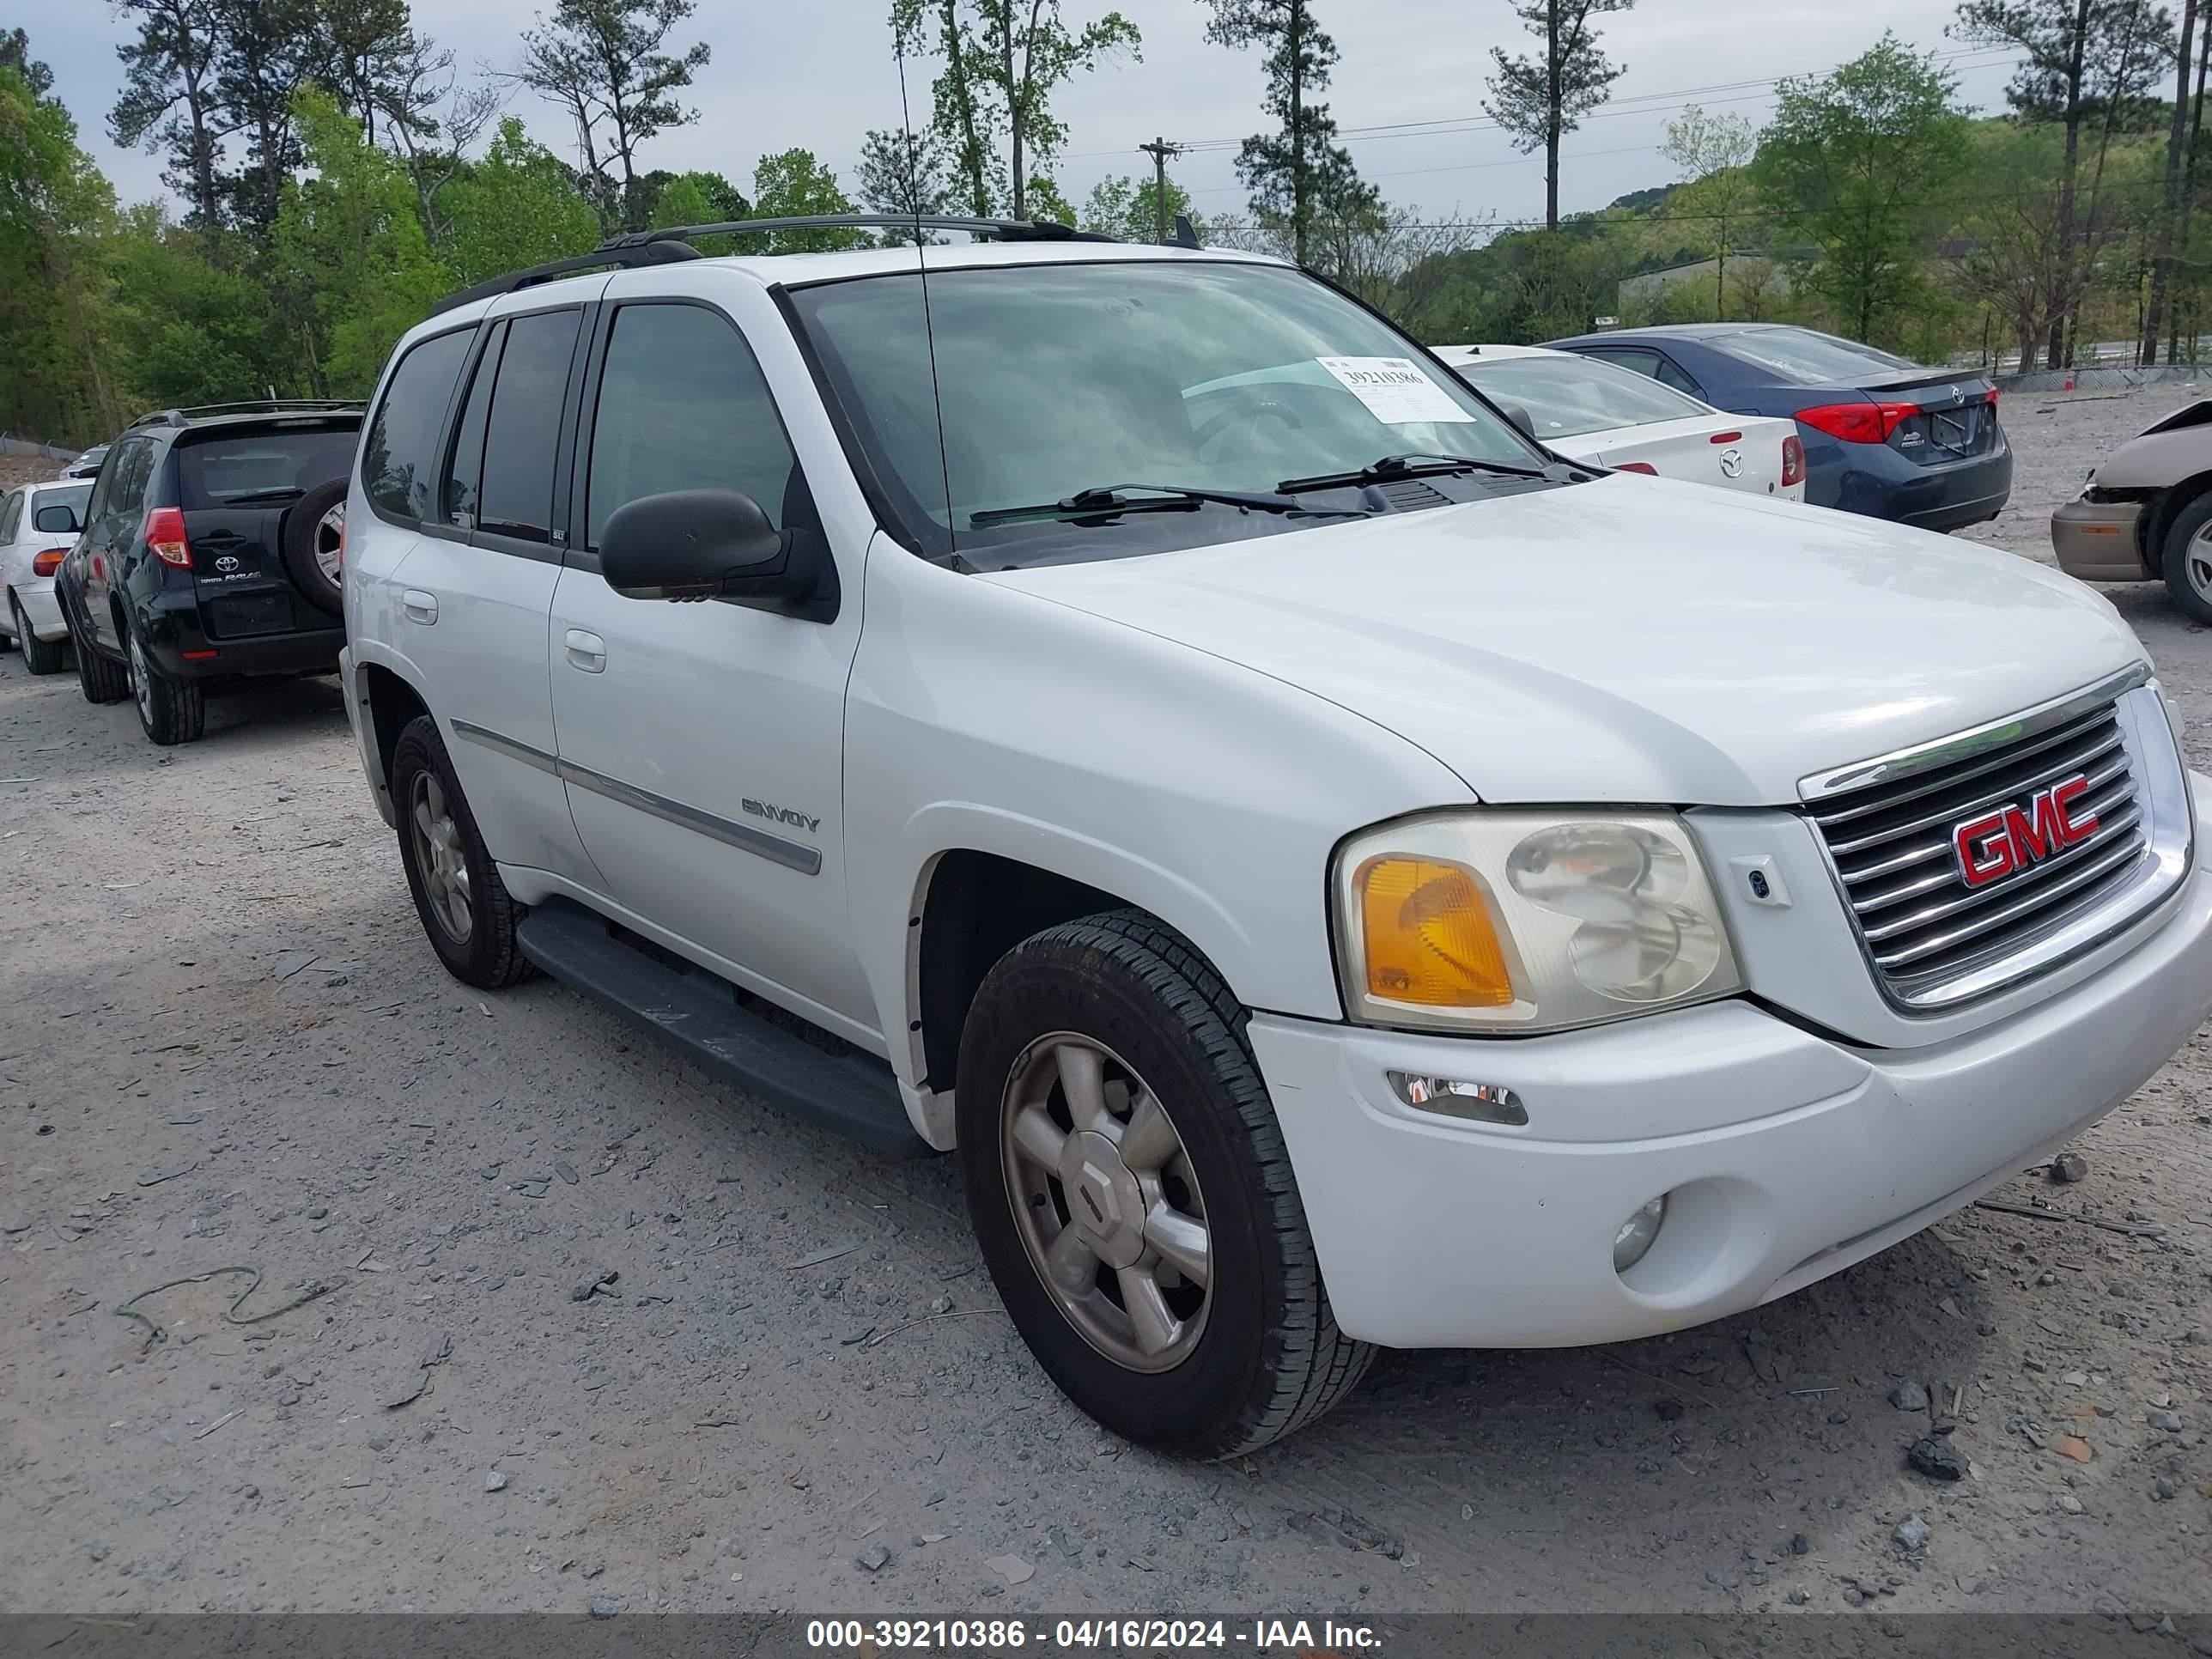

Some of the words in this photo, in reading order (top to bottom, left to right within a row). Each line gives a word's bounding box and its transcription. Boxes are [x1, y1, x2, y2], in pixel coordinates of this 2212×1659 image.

[1344, 372, 1424, 384] 39210386
[741, 797, 821, 833] ENVOY
[1951, 773, 2100, 889] GMC
